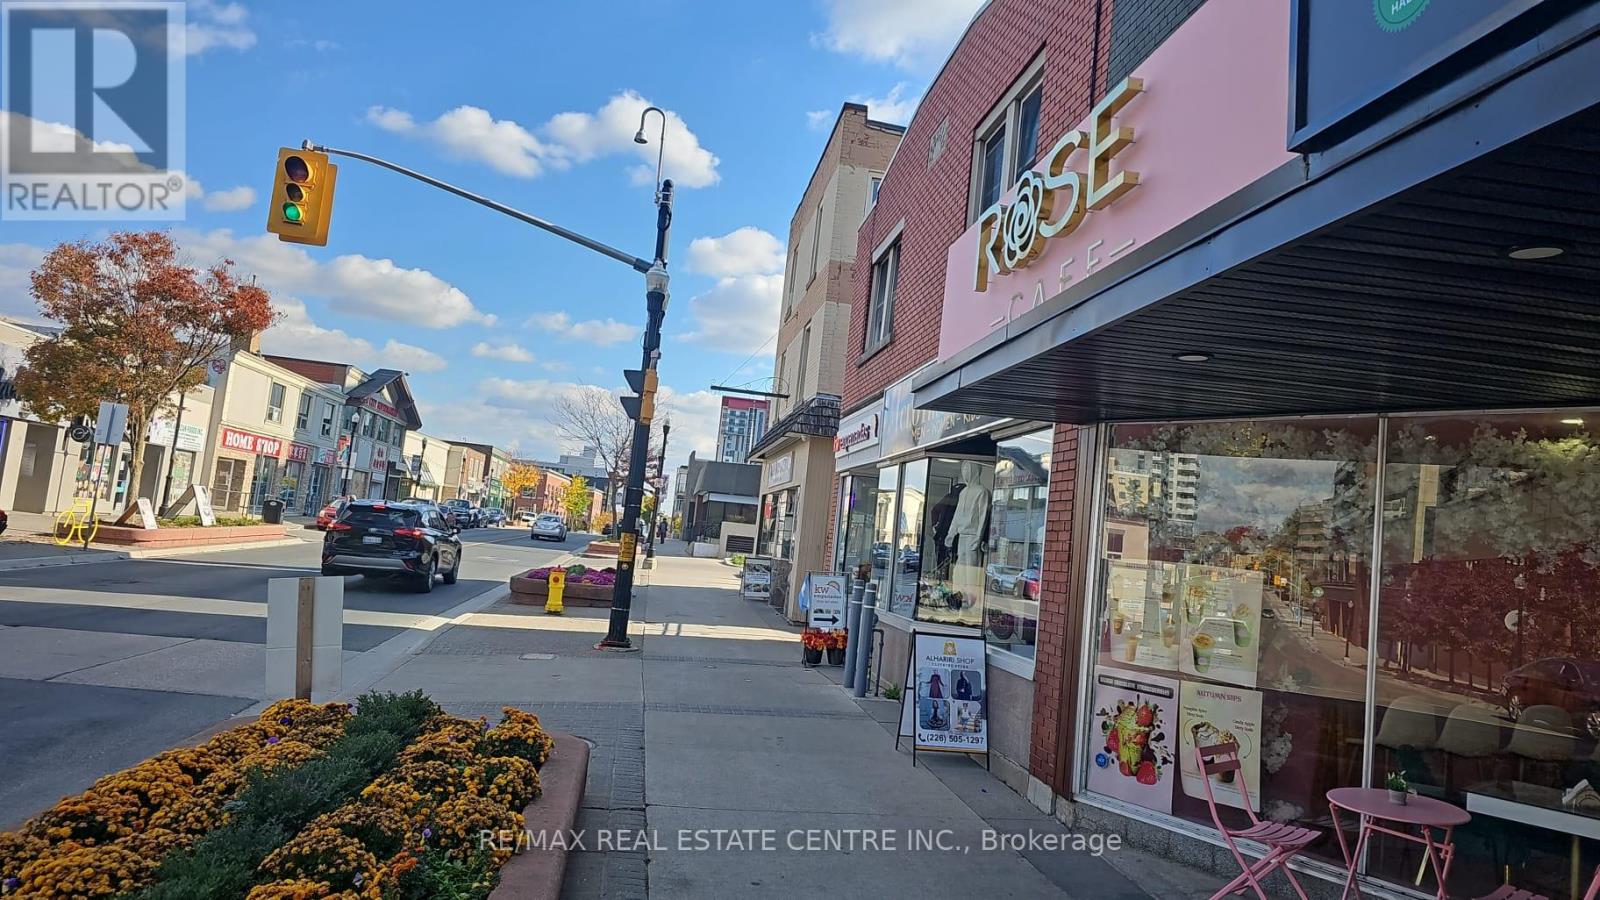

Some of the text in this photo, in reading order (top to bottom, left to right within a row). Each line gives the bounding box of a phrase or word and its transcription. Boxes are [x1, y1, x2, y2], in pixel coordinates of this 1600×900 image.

[225, 430, 254, 450] HOME
[956, 657, 974, 665] SHOP
[1196, 689, 1242, 702] AUTUMN SIPS
[927, 734, 984, 745] (226) 505-1297
